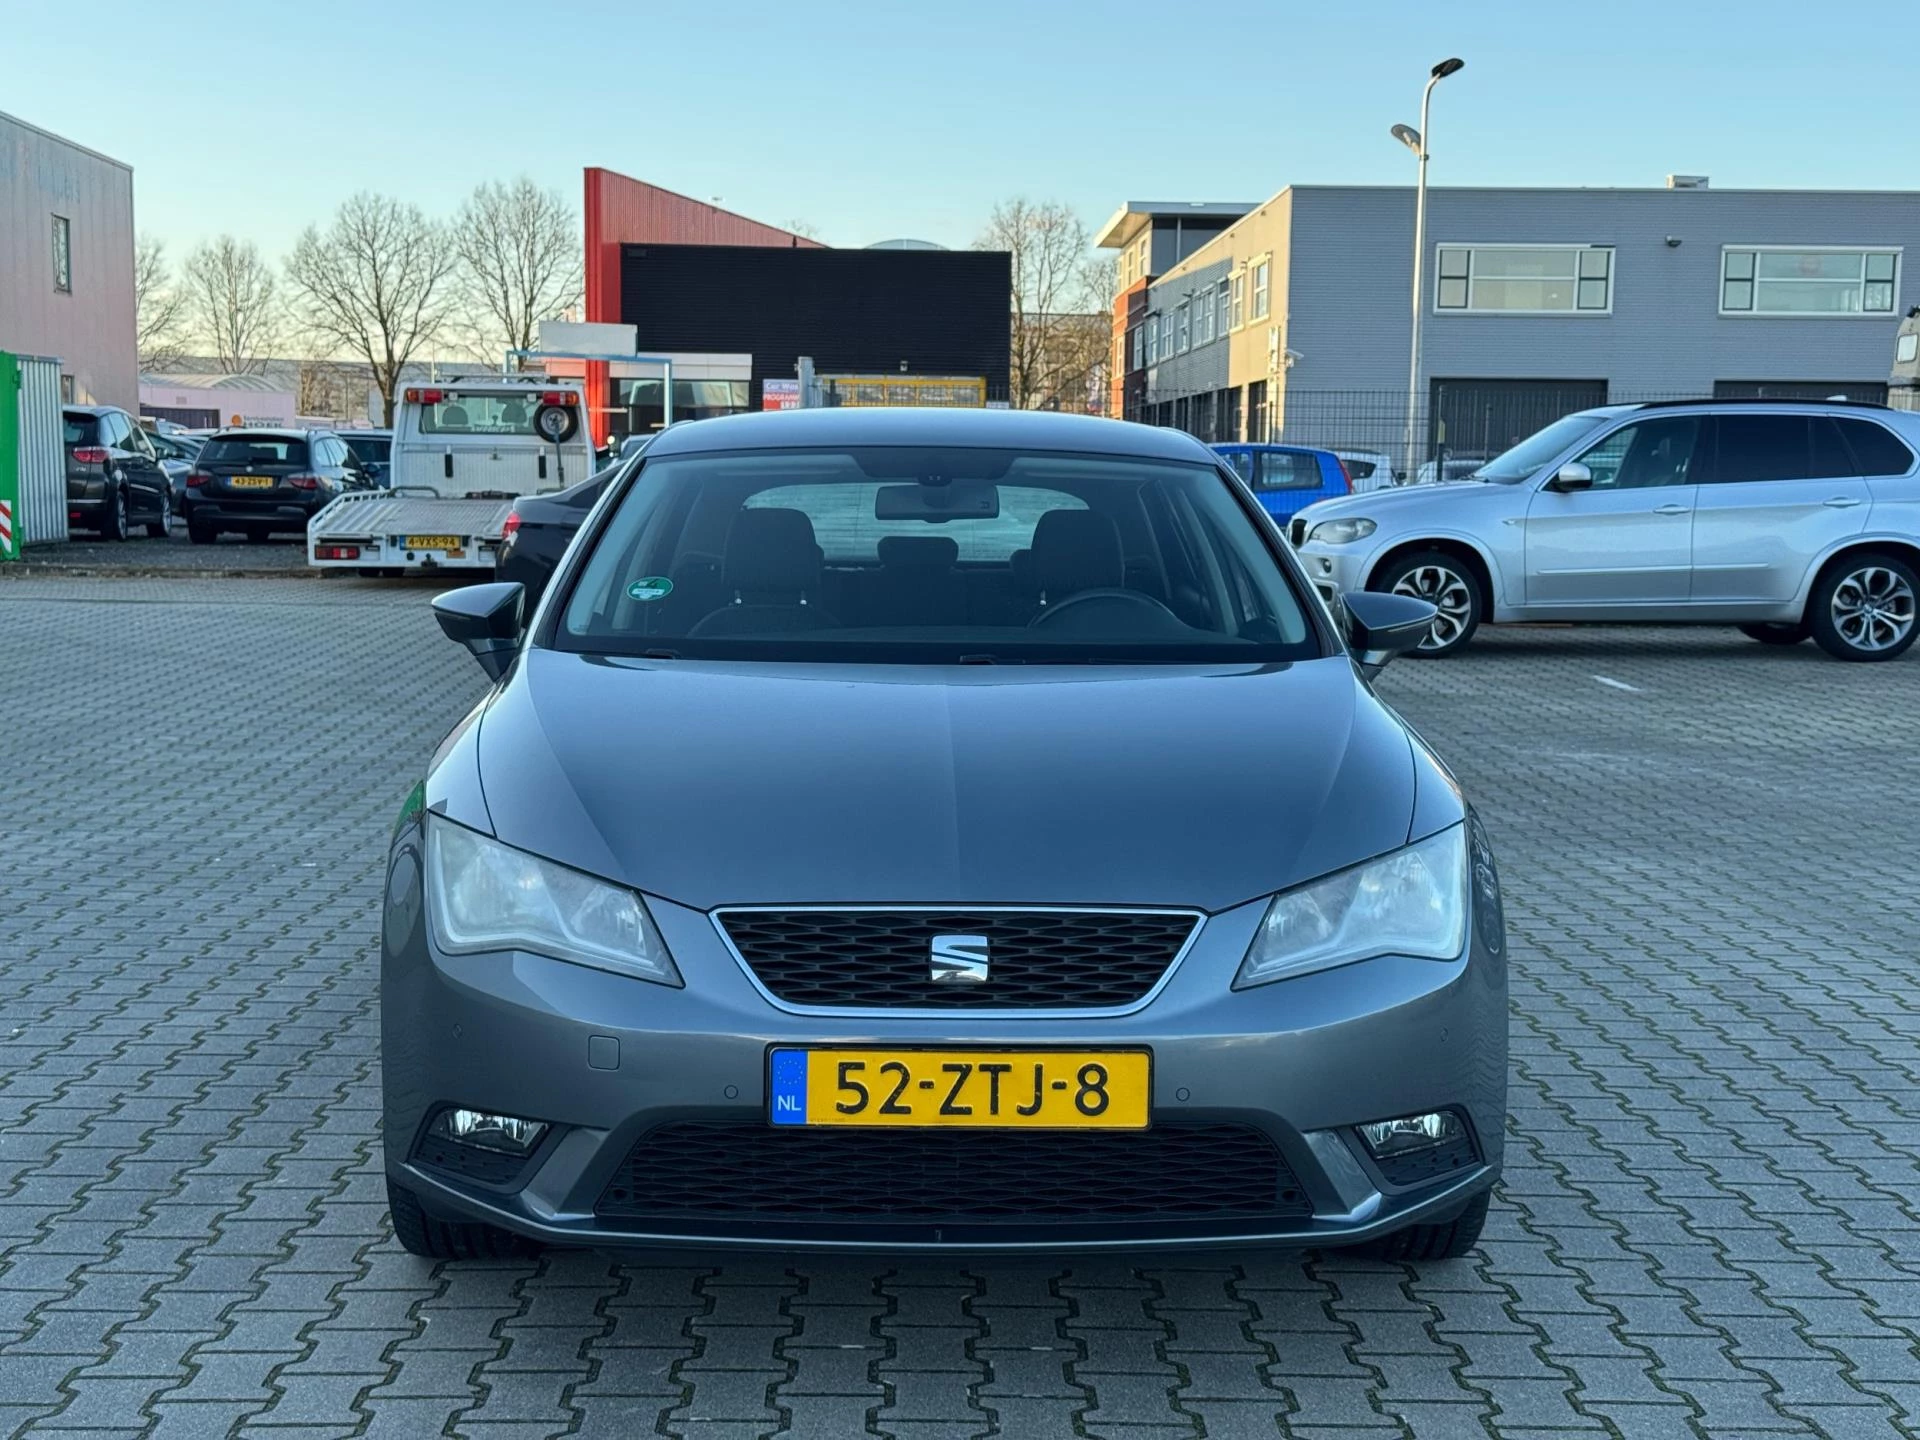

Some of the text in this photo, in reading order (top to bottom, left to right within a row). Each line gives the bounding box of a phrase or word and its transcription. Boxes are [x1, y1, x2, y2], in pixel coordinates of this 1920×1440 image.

[408, 536, 456, 546] 4-VXS-94
[777, 1062, 1110, 1116] NL 52-ZTJ-8
